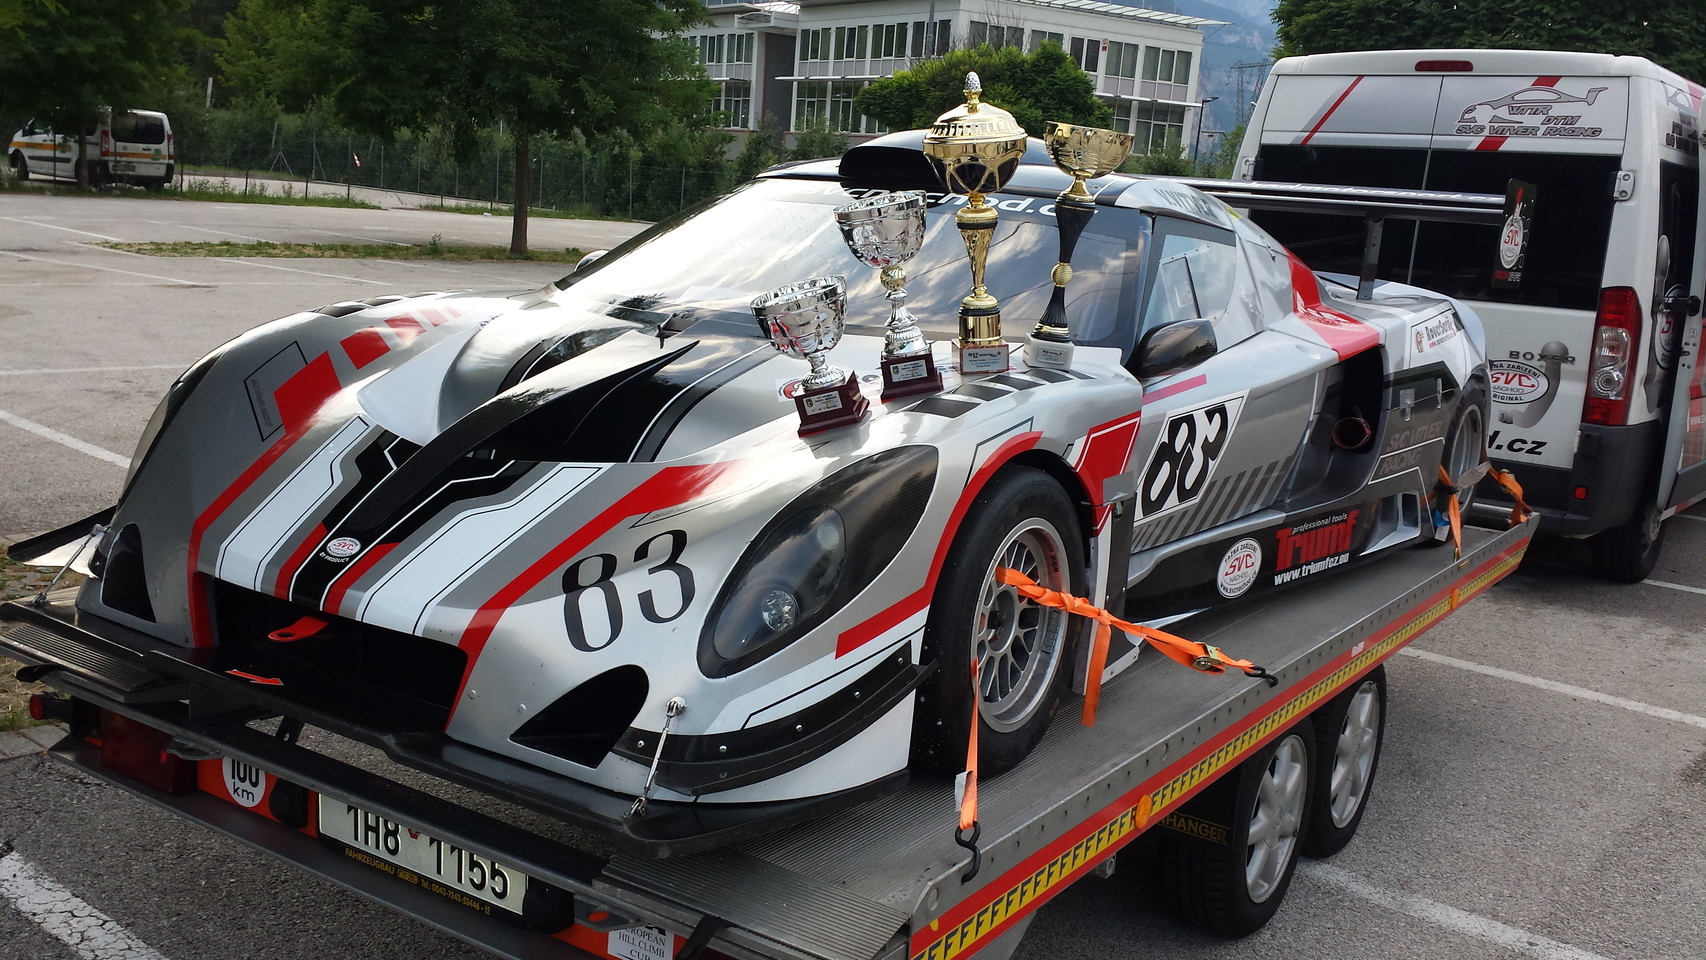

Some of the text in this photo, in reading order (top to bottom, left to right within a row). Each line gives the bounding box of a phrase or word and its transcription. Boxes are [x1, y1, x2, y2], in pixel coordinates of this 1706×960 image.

[1455, 125, 1602, 137] SVC VITVER RACING
[1541, 115, 1581, 125] DTM
[1504, 229, 1519, 246] SVC
[1509, 350, 1576, 365] BOXER
[1491, 372, 1536, 388] SVC
[1141, 404, 1228, 517] 83
[1292, 513, 1348, 535] professional tools
[333, 541, 354, 551] SVC
[1276, 510, 1359, 571] Triumf
[1225, 553, 1255, 577] SVC
[1274, 553, 1350, 586] www.triumfcz.eu
[562, 529, 696, 653] 83
[232, 759, 260, 788] 100
[233, 781, 255, 802] km
[1160, 813, 1227, 844] HÄNGER
[345, 848, 395, 875] FAHRZEUGBAU
[347, 804, 511, 900] 1H8 1155
[618, 932, 665, 958] HILL CLIMB
[624, 928, 666, 947] UROPEAN
